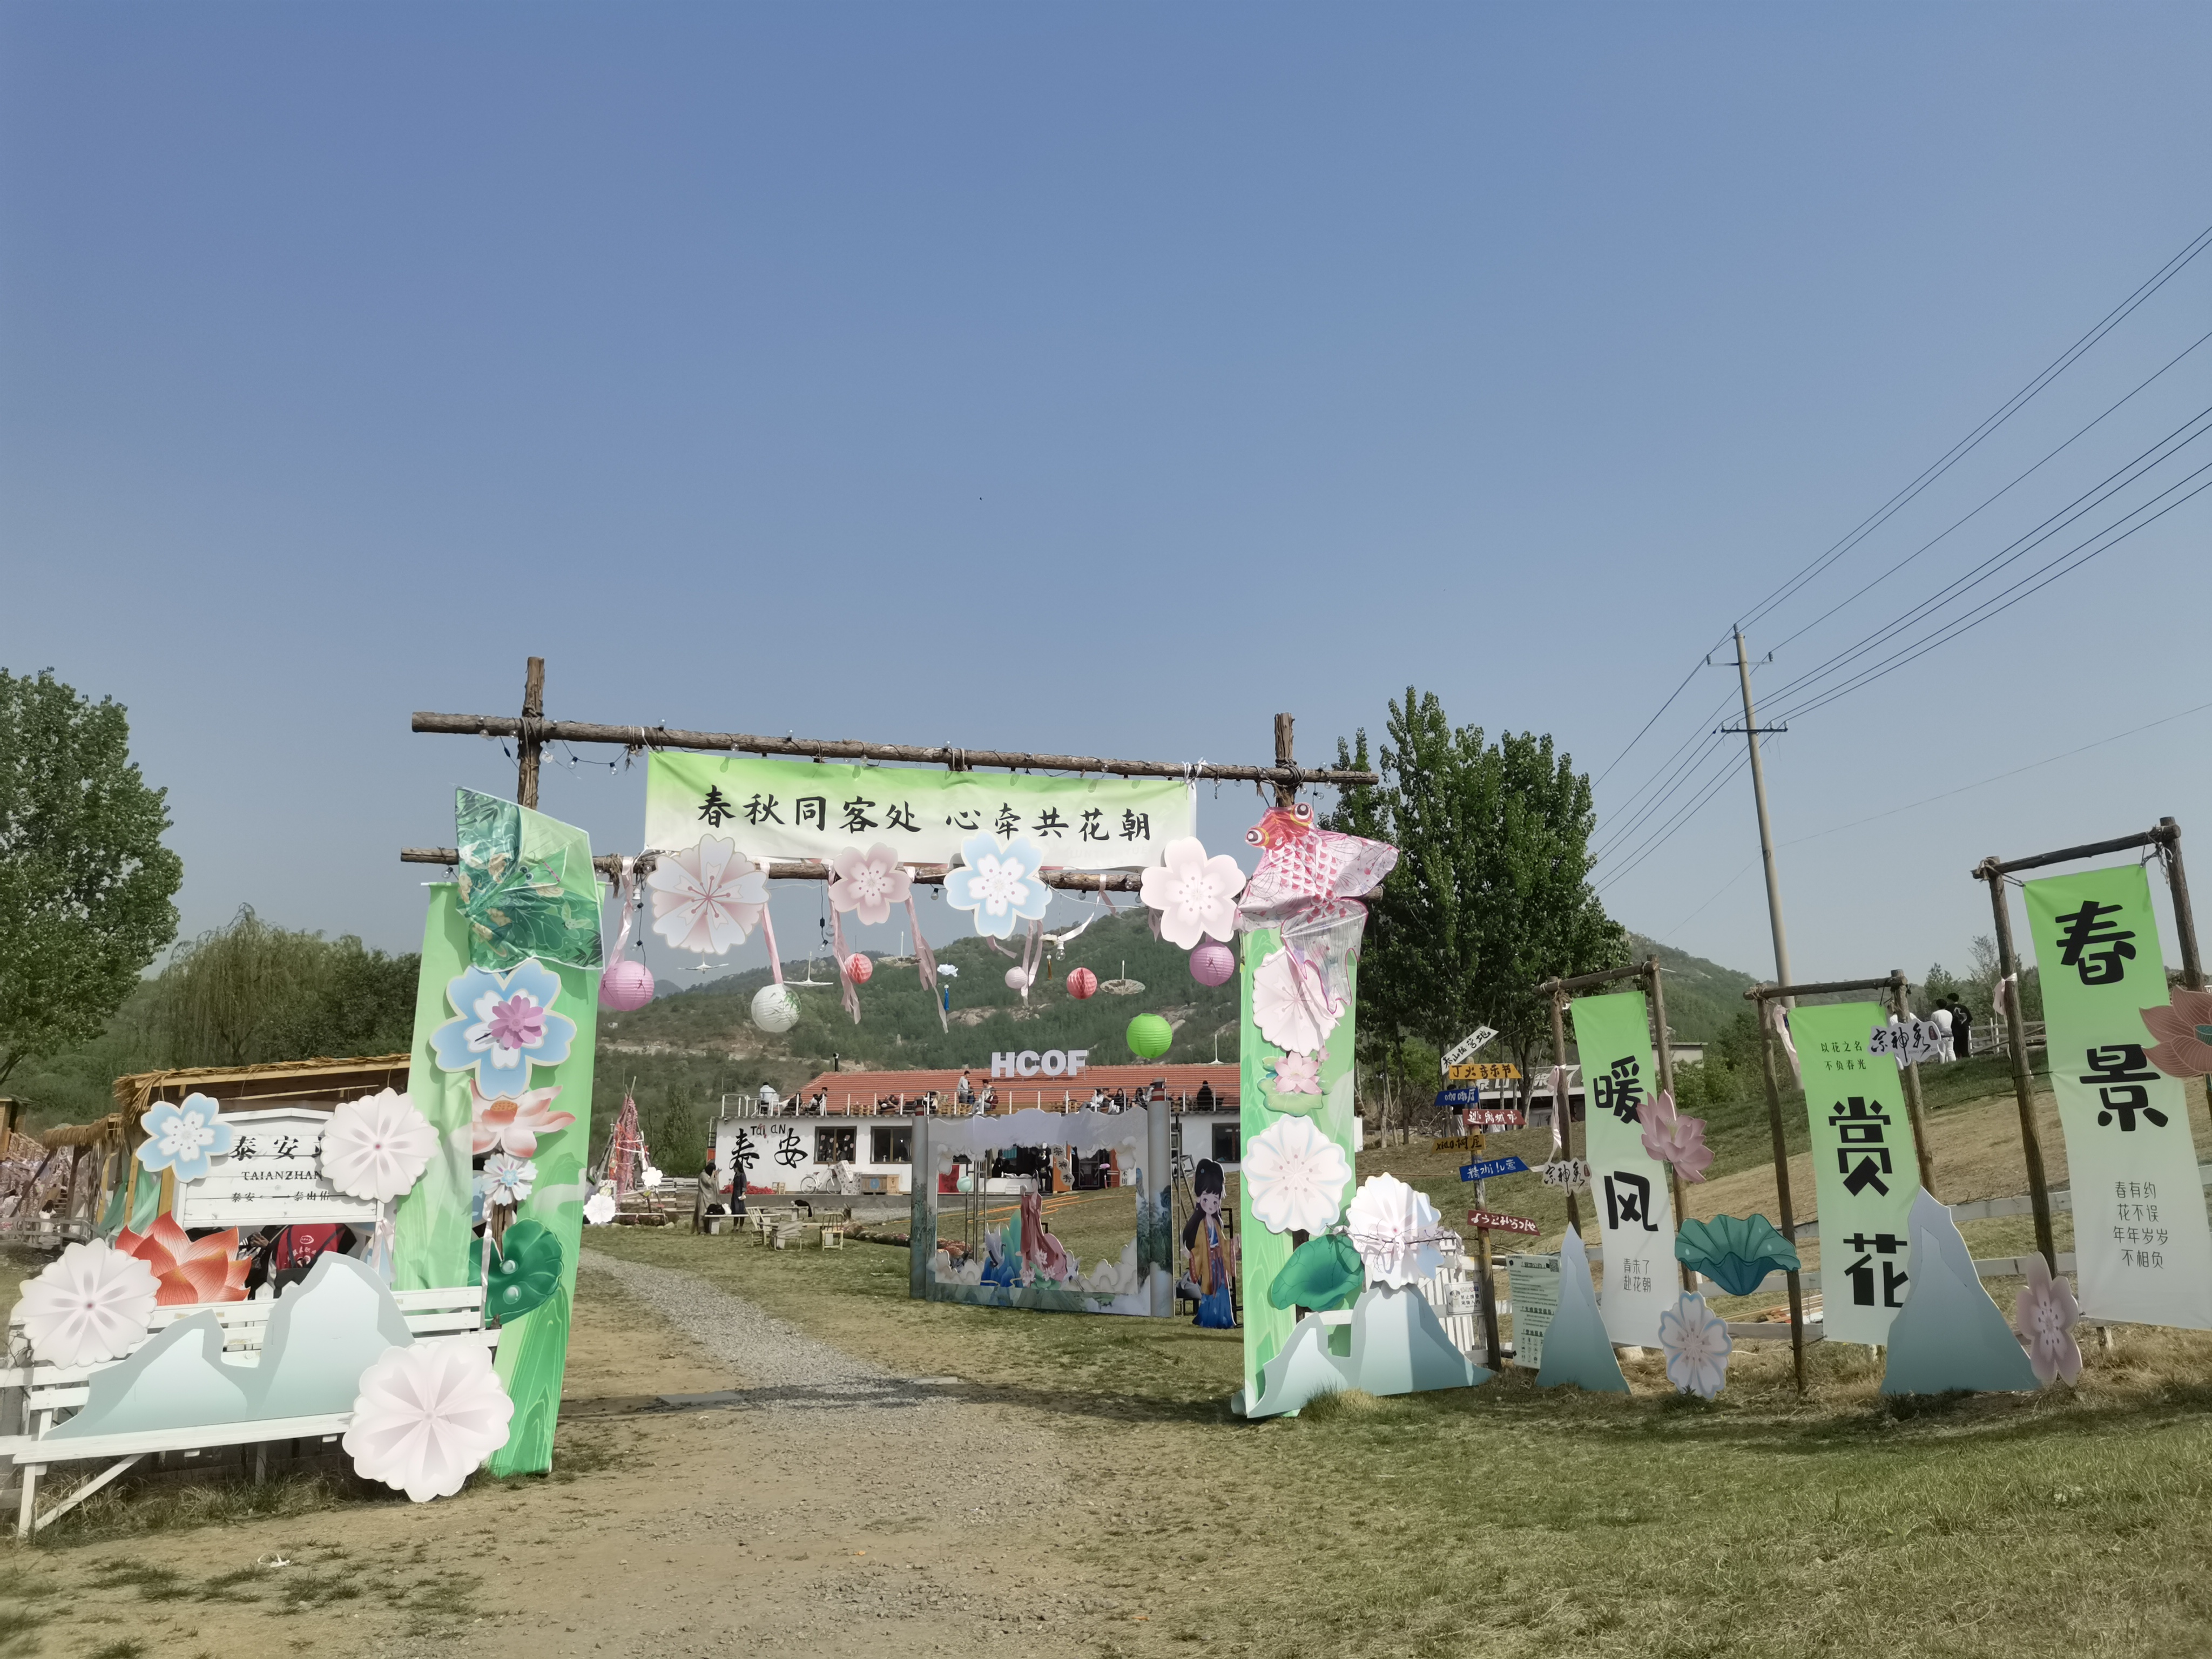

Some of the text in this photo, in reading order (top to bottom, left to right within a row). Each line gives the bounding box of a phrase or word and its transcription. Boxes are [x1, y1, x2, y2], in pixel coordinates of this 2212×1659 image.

[697, 785, 1151, 842] 春秋同客处 心牵共花朝
[2055, 900, 2168, 1132] 春景
[1820, 1040, 1862, 1053] 以花之名
[992, 1049, 1088, 1077] HCOF
[1824, 1059, 1866, 1070] 不负春光
[729, 1128, 808, 1170] 泰安
[1593, 1055, 1658, 1232] 暖风
[1053, 1148, 1072, 1183] 宗神秀
[2115, 1181, 2156, 1199] 春有约
[1829, 1096, 1911, 1308] 赏花
[2117, 1203, 2159, 1223] 花不误
[2113, 1226, 2168, 1245] 年年岁岁
[1623, 1258, 1650, 1275] 青未了
[2121, 1249, 2163, 1269] 不相负
[1623, 1275, 1651, 1293] 赴花朝
